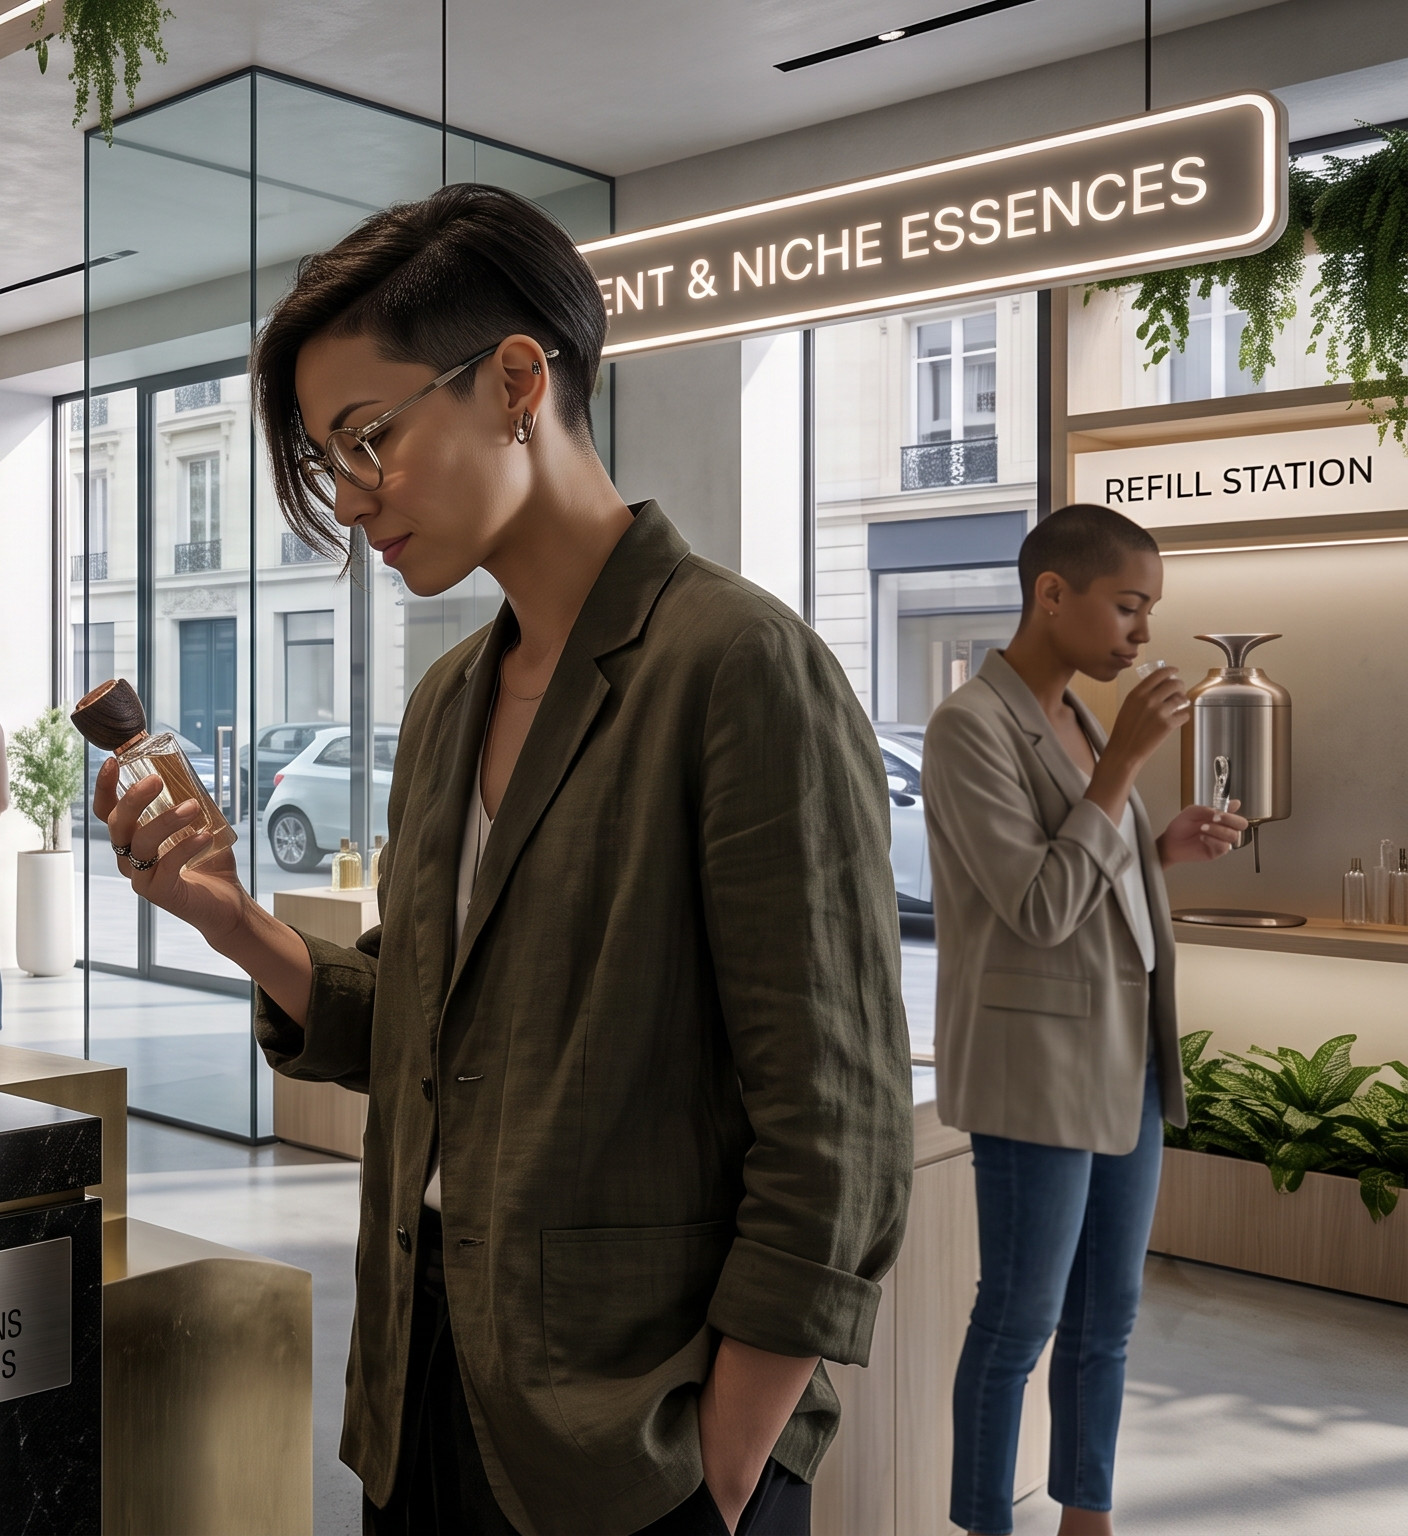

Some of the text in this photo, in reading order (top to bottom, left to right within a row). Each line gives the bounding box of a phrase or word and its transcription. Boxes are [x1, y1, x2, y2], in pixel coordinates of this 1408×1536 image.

[687, 258, 718, 300] &
[733, 223, 883, 291] NICHE
[902, 156, 1208, 258] ESSENCES
[1105, 455, 1372, 504] REFILL STATION
